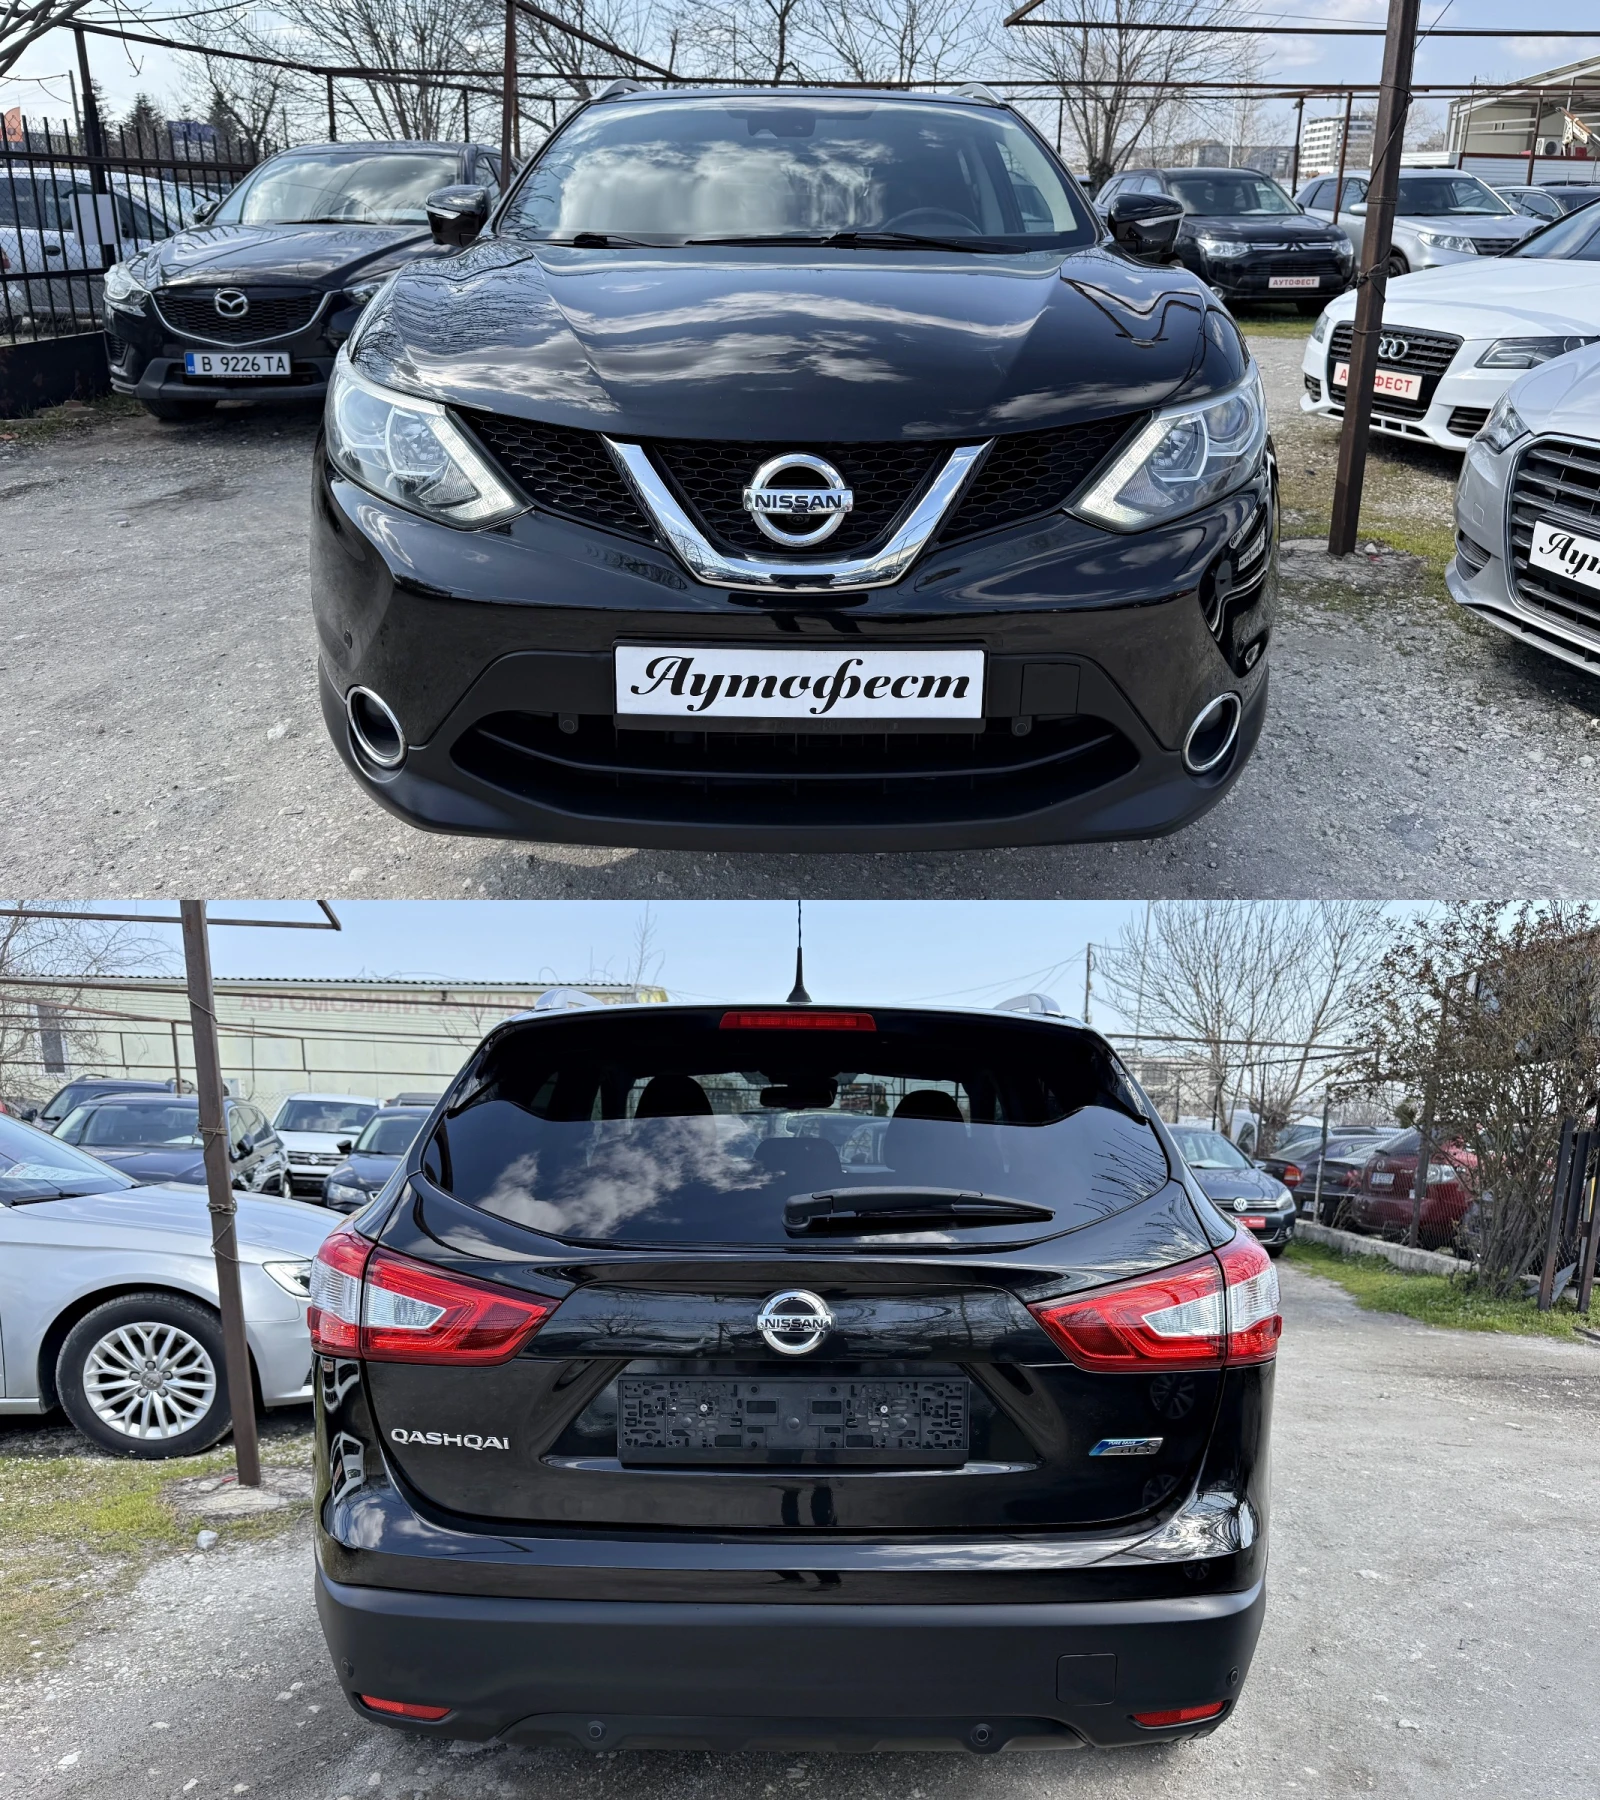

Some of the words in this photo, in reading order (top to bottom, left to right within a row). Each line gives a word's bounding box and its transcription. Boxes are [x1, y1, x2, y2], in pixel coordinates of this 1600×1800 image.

[201, 356, 212, 372] B
[220, 356, 261, 372] 9226
[264, 356, 286, 372] TA
[1339, 368, 1413, 393] АФЕСТ
[754, 494, 842, 509] NISSAN
[630, 655, 970, 715] Аутофест
[764, 1318, 824, 1328] NISSAN
[390, 1428, 510, 1450] QASHQAI
